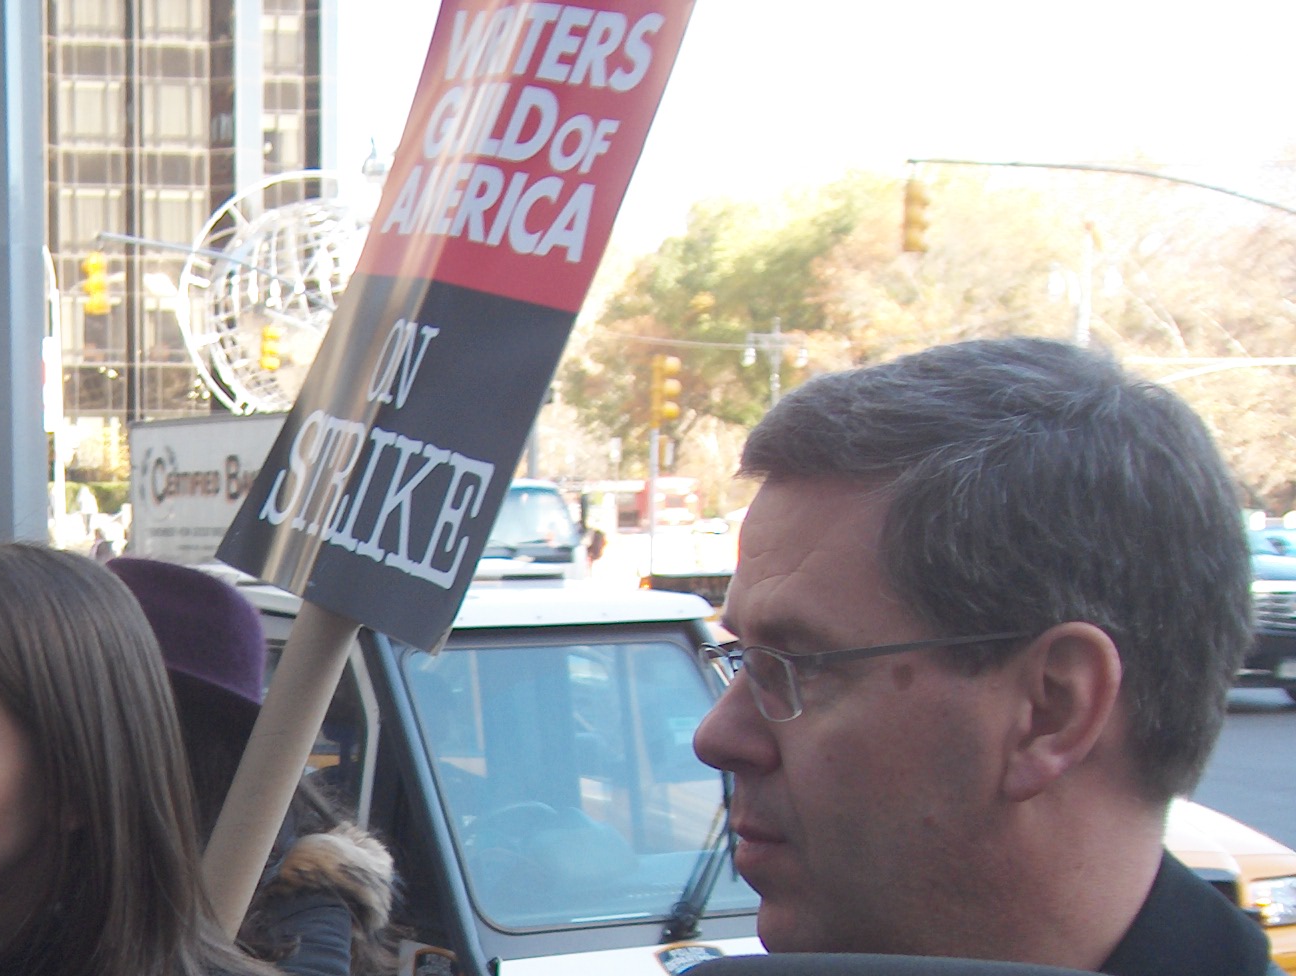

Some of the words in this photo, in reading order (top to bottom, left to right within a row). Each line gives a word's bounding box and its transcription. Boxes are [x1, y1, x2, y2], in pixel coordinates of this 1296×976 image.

[549, 113, 621, 174] OF
[367, 318, 441, 410] ON
[258, 409, 496, 591] STRIKE
